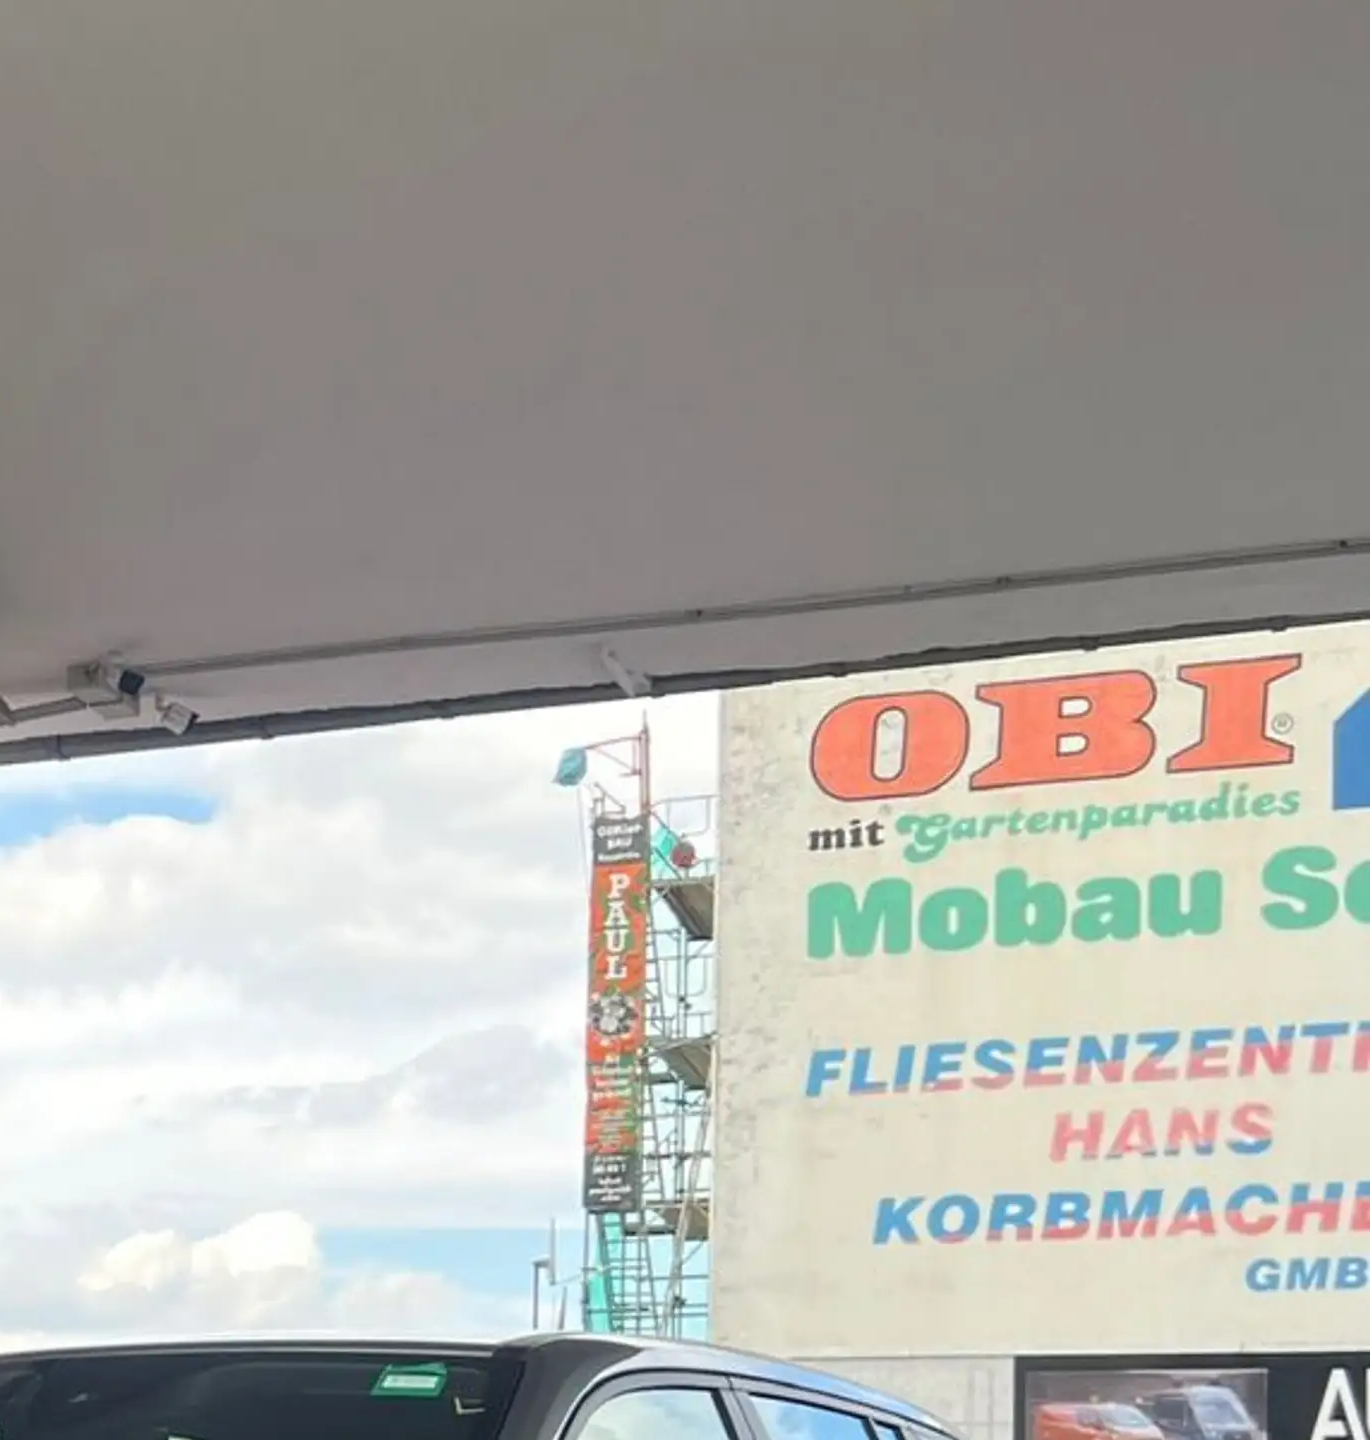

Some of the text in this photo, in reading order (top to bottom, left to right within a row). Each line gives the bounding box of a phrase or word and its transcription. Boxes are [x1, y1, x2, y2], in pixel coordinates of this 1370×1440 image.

[809, 653, 1302, 801] OBI
[808, 781, 1301, 862] mit Gartenparadies
[604, 872, 631, 981] PAUL
[806, 867, 1223, 960] Mobau
[1048, 1102, 1274, 1163] HANS
